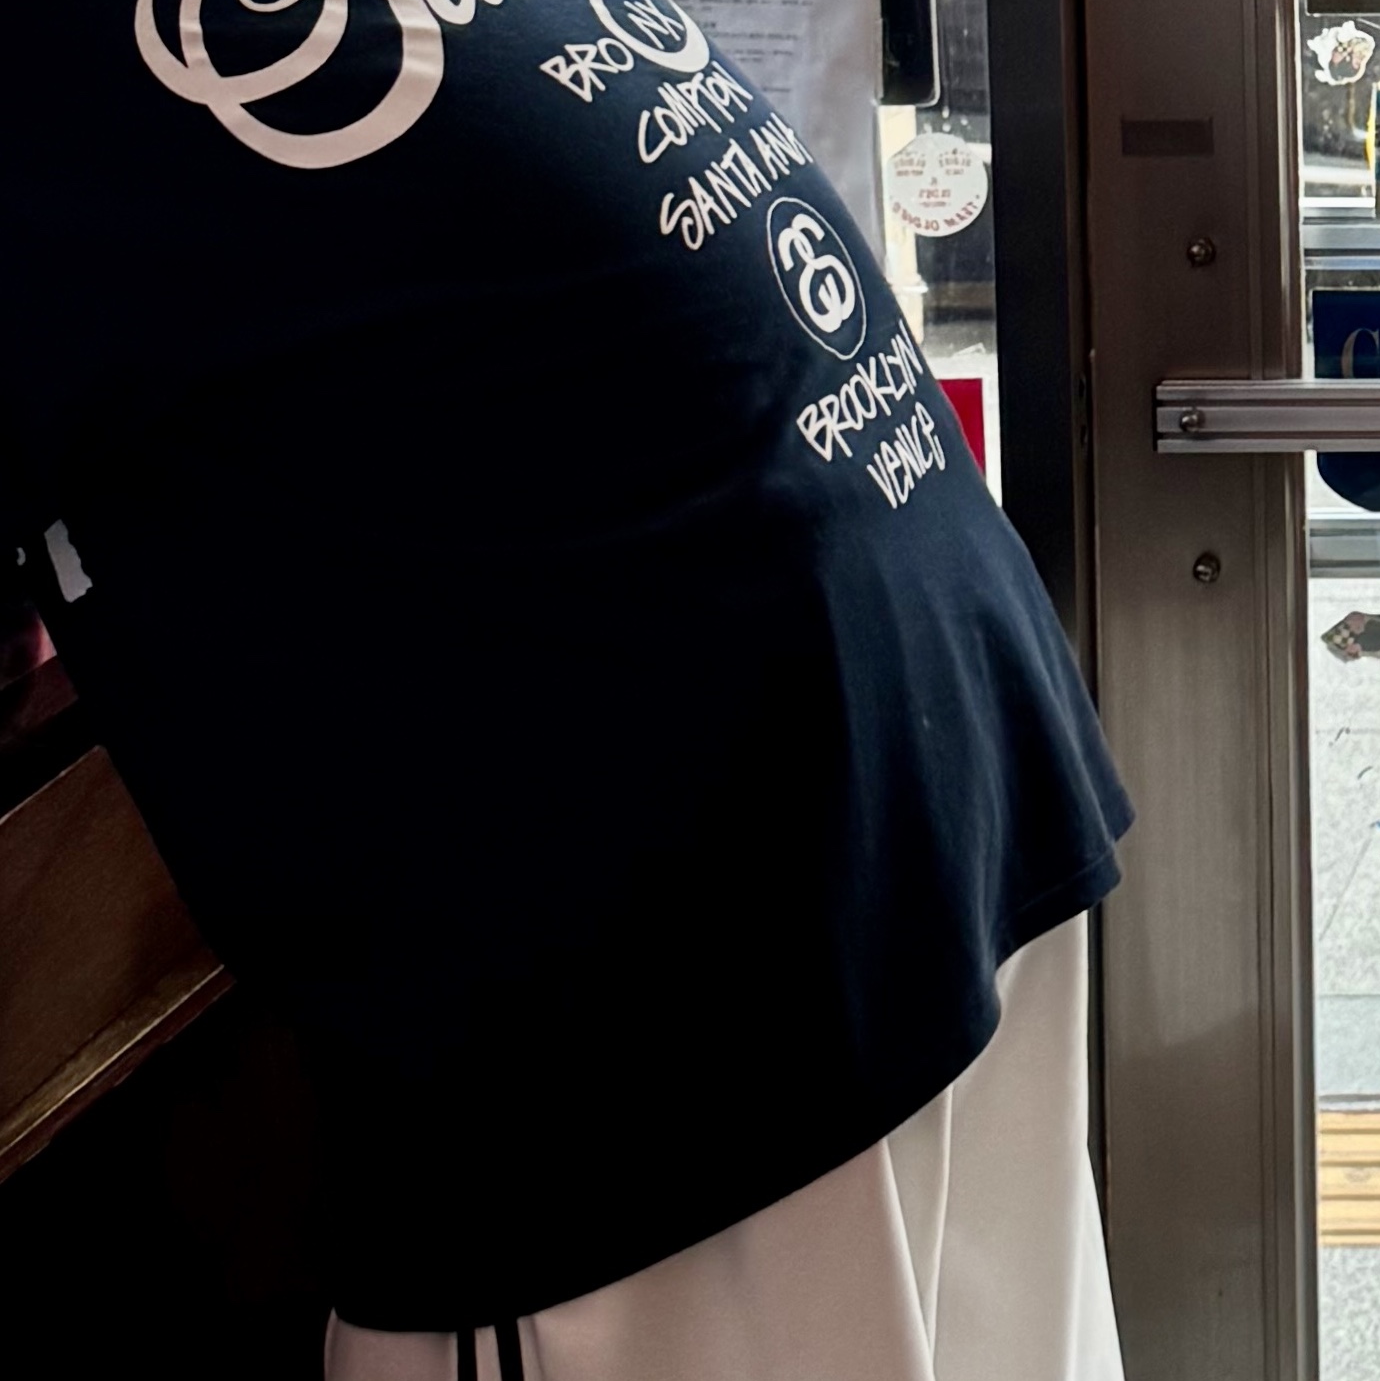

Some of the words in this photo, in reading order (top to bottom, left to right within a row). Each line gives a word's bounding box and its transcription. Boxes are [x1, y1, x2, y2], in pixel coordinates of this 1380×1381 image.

[637, 60, 754, 164] COMPTON
[659, 139, 768, 252] SANTA
[796, 321, 923, 462] BROOKLYN
[867, 401, 946, 509] VENICE
